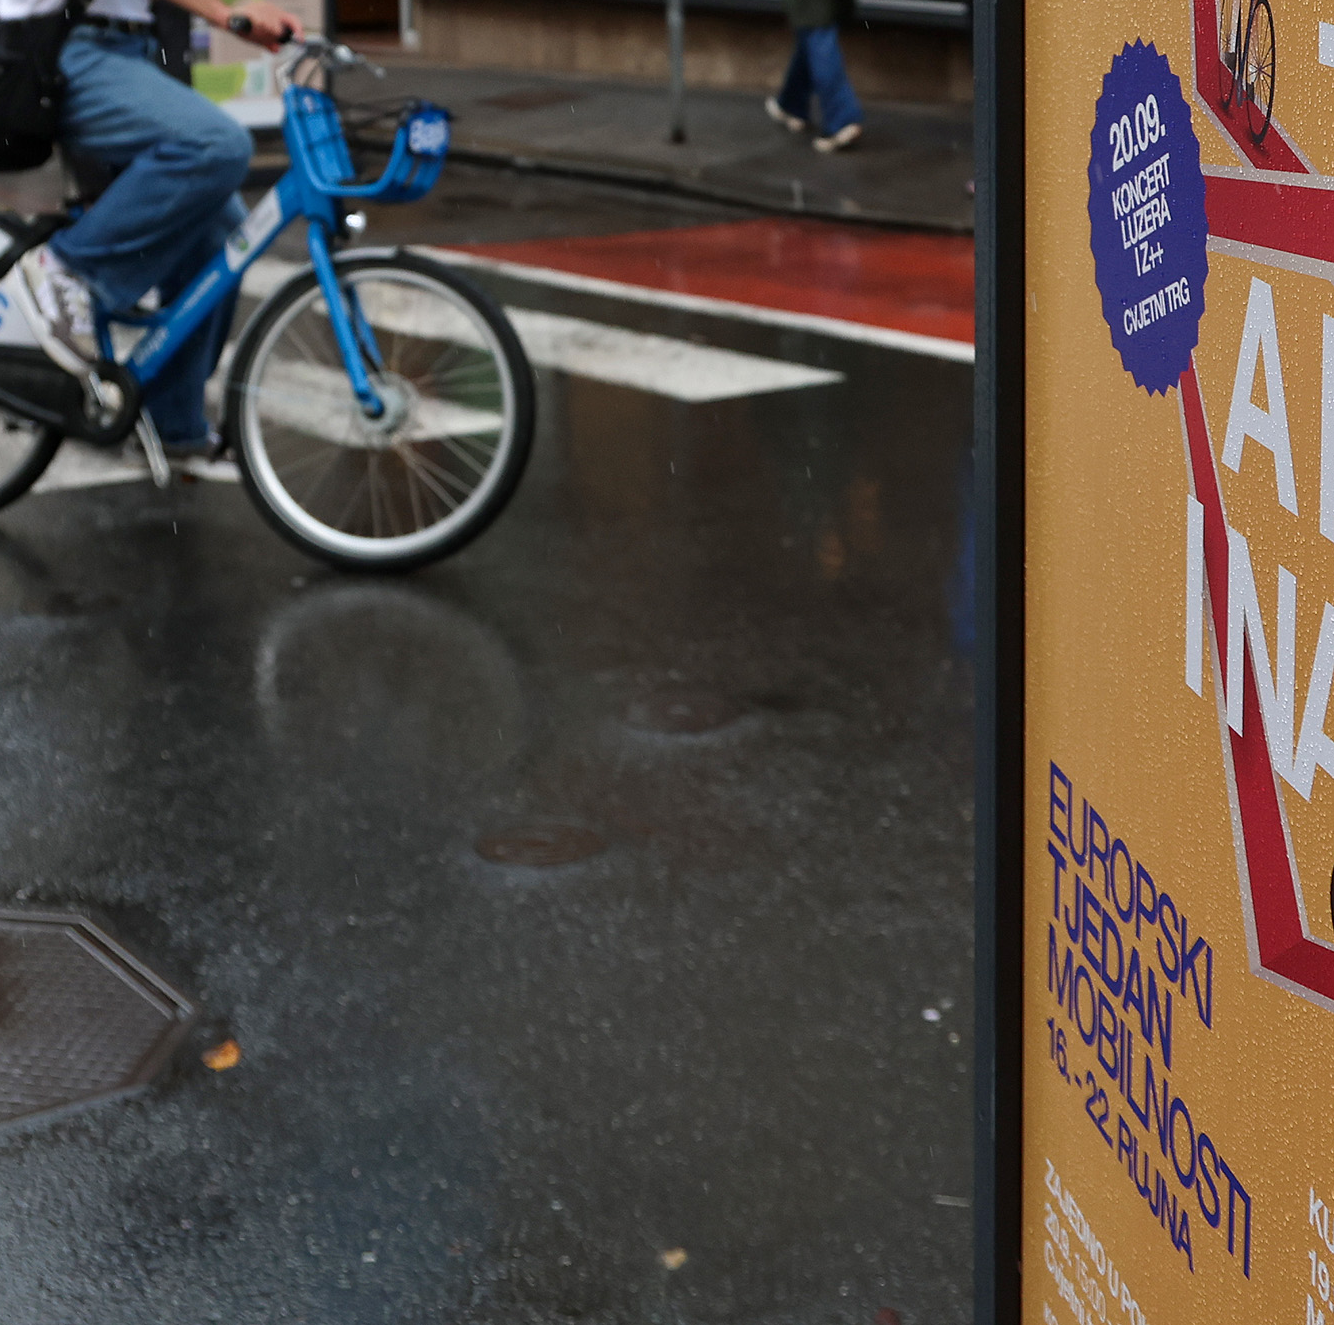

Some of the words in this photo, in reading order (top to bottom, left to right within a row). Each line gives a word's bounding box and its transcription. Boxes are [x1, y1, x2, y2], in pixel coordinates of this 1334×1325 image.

[1109, 93, 1167, 173] 20.09.
[1111, 152, 1171, 221] KONCERT
[1120, 189, 1173, 251] LUZERA
[1123, 289, 1166, 336] CVJETNI
[1165, 276, 1191, 312] TRG
[1221, 276, 1299, 518] A
[1047, 838, 1172, 1073] TJEDAN
[1050, 759, 1213, 1030] EUROPSKI
[1047, 1016, 1071, 1086] 16.
[1117, 1113, 1195, 1276] RUJNA
[1048, 922, 1251, 1281] MOBILNOSTI
[1044, 1157, 1106, 1276] ZAJEDNO
[1107, 1258, 1120, 1299] U
